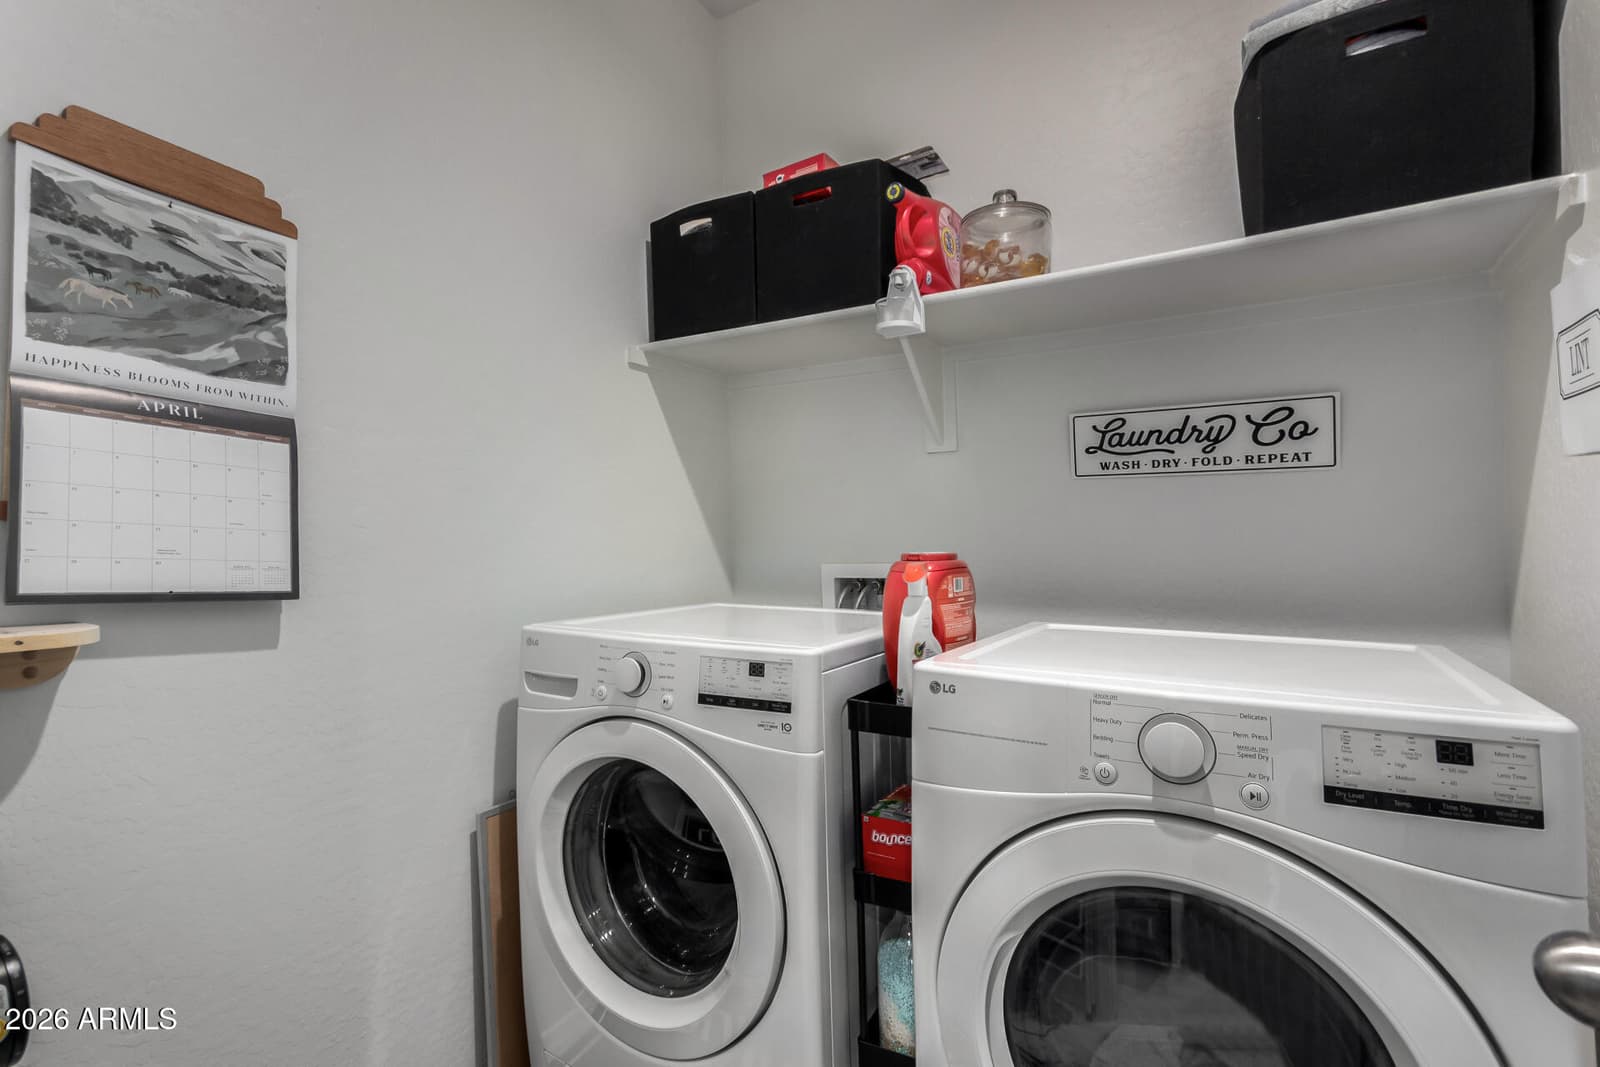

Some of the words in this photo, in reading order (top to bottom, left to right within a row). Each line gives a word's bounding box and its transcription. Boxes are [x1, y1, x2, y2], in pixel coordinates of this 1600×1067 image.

[1569, 338, 1590, 376] LINT
[25, 352, 122, 377] HAPPINESS
[128, 371, 190, 389] BLOOMS
[196, 383, 234, 398] FROM
[238, 391, 290, 408] WITHIN.
[137, 399, 203, 420] APRIL
[1085, 414, 1236, 455] Laundry
[1245, 406, 1319, 447] Co
[1100, 460, 1141, 471] WASH
[1151, 458, 1181, 469] DRY
[1191, 455, 1233, 467] FOLD
[1244, 452, 1312, 465] REPEAT
[942, 683, 956, 694] LG
[1093, 716, 1109, 725] Heavy
[1110, 718, 1122, 727] Duty
[1239, 712, 1268, 721] Delicates
[1252, 733, 1269, 741] Press
[1258, 753, 1269, 762] Dry
[1258, 773, 1271, 782] Dry
[871, 829, 912, 846] bounce
